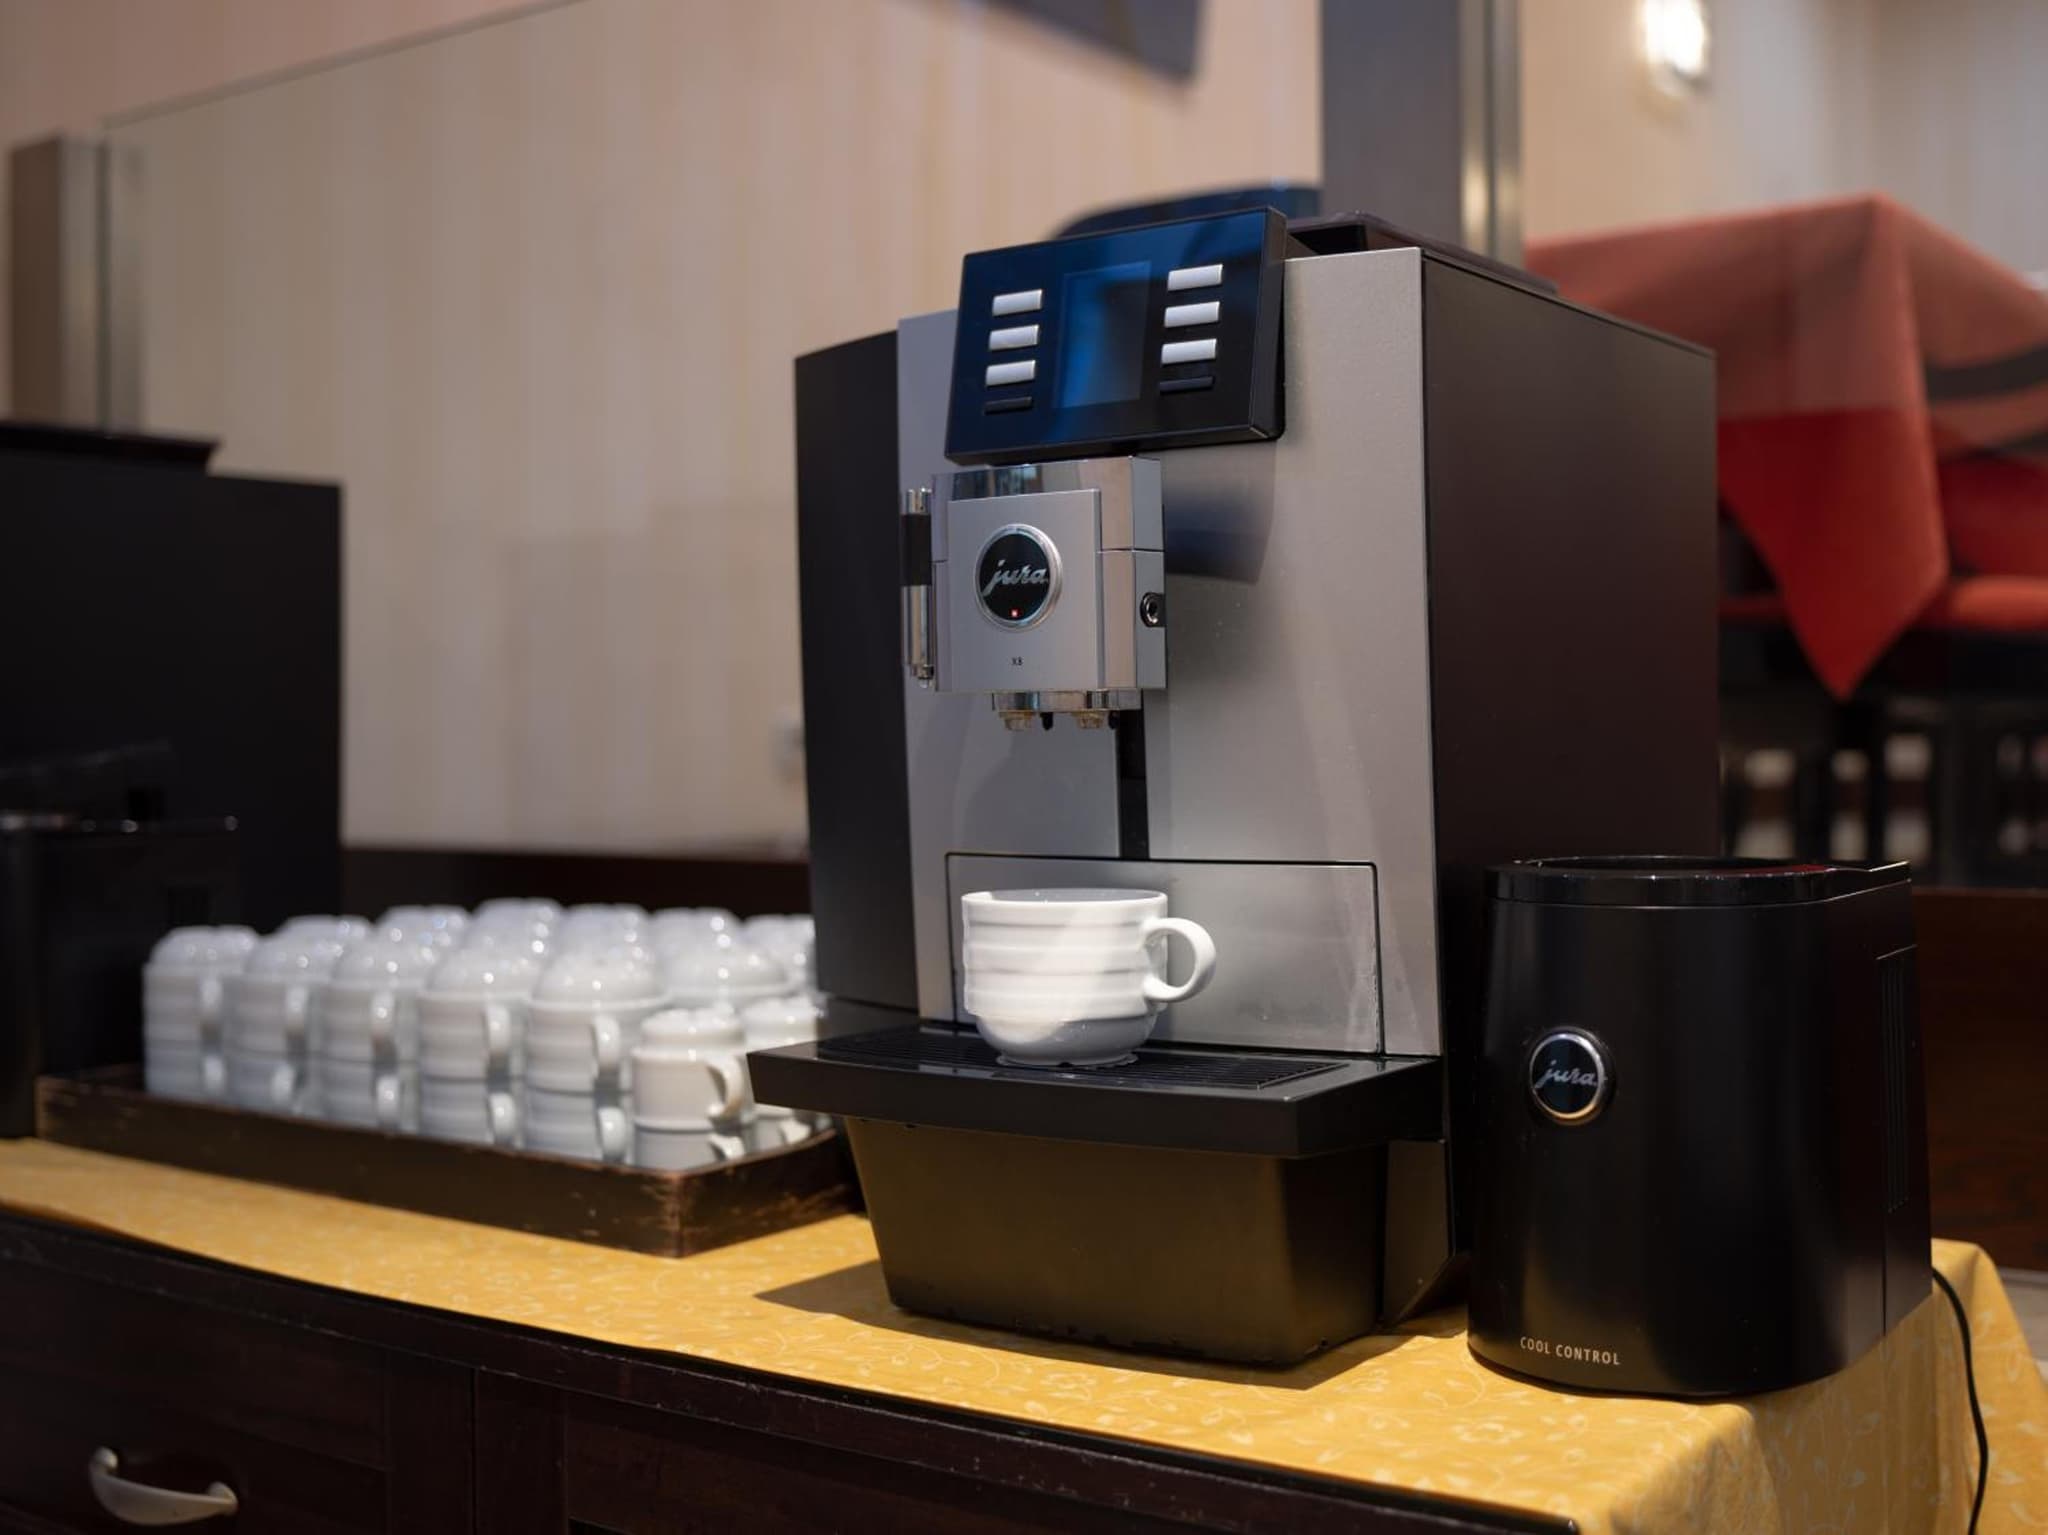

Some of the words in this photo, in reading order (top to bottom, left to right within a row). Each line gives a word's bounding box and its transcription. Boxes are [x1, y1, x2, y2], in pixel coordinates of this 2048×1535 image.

[982, 559, 1048, 597] jura
[1534, 1059, 1597, 1088] jura
[1520, 1336, 1551, 1354] COOL
[1555, 1344, 1620, 1365] CONTROL
